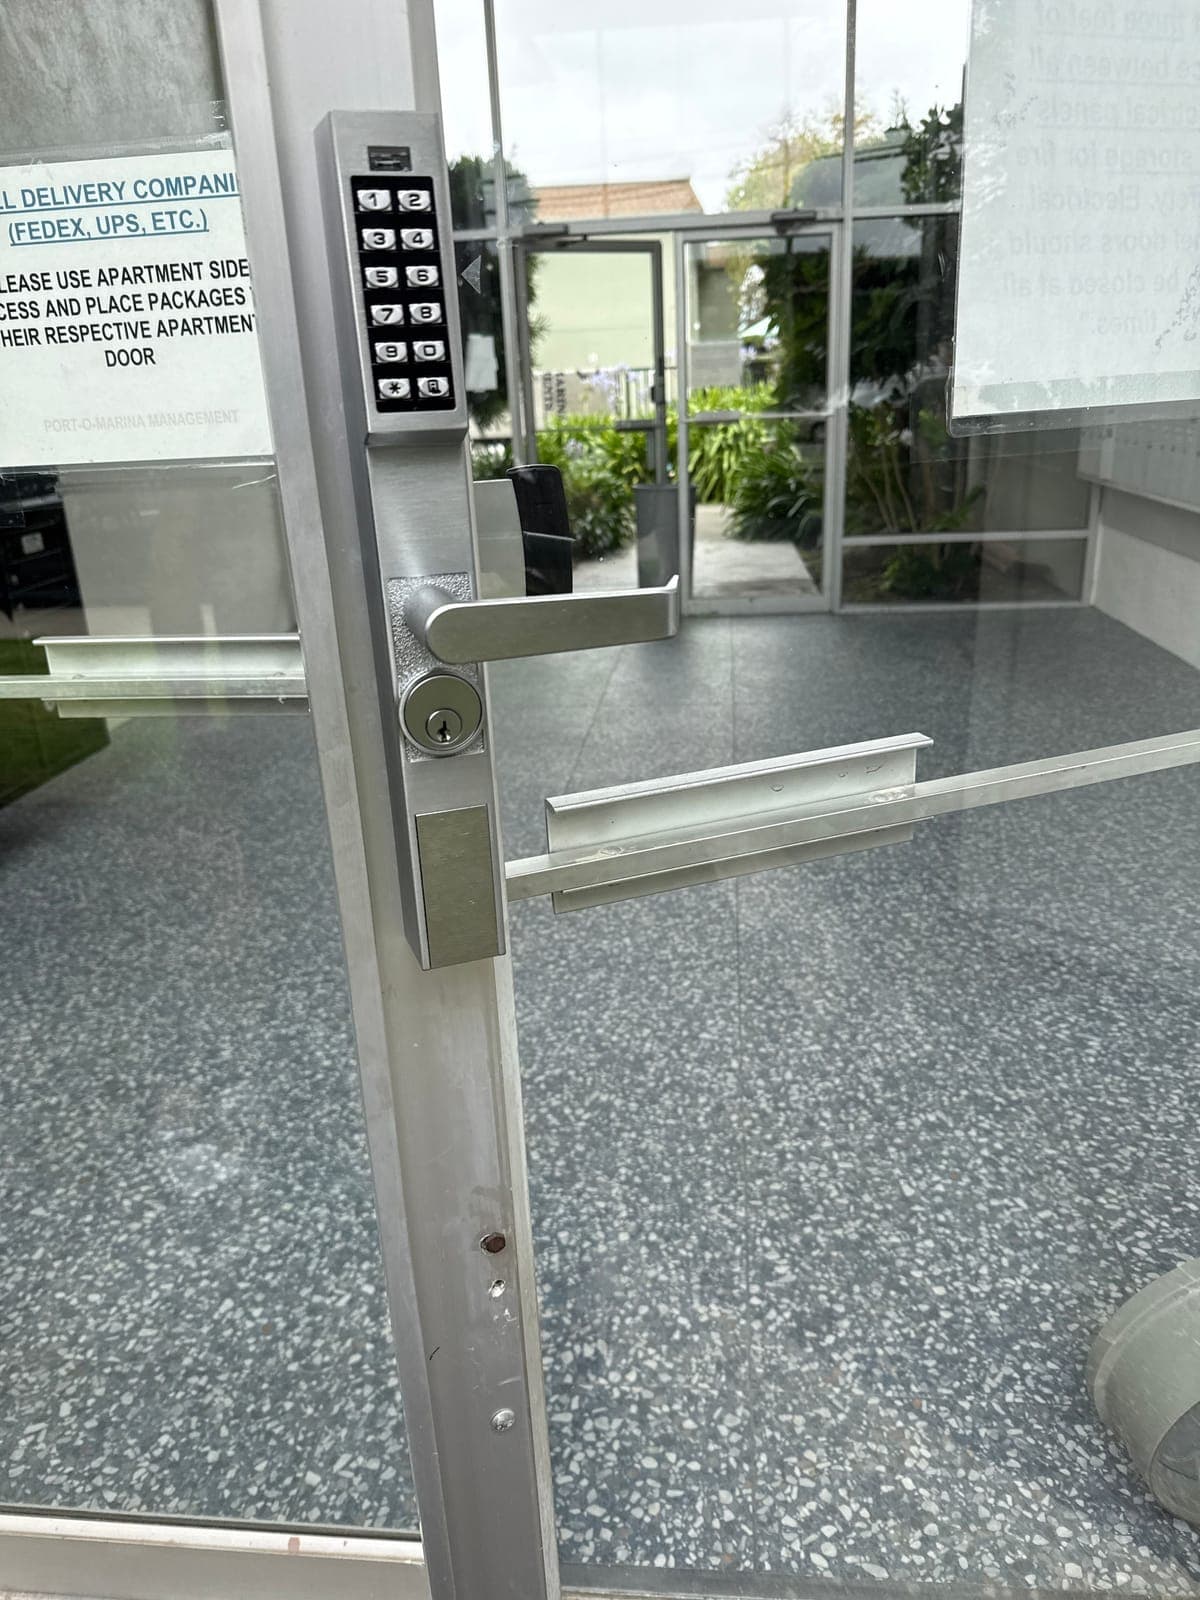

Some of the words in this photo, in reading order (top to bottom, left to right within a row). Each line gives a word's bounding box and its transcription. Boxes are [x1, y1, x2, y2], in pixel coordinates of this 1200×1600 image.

[0, 191, 16, 210] L
[21, 180, 126, 208] DELIVERY
[133, 172, 240, 199] COMPANI
[367, 193, 378, 207] 1
[409, 194, 421, 207] 2
[9, 217, 91, 244] (FEDEX,
[96, 213, 146, 236] UPS,
[151, 208, 208, 231] ETC.)
[373, 232, 386, 245] 3
[411, 232, 424, 245] 4
[56, 269, 93, 290] USE
[97, 261, 203, 287] APARTMENT
[376, 271, 389, 284] 5
[416, 269, 429, 282] 6
[46, 297, 81, 317] AND
[85, 293, 144, 315] PLACE
[147, 286, 246, 311] PACKAGES
[381, 307, 394, 321] 7
[420, 306, 433, 319] 8
[0, 327, 41, 347] HEIR
[44, 320, 152, 345] RESPECTIVE
[157, 313, 255, 338] APARTMEN
[104, 347, 156, 367] DOOR
[386, 345, 398, 358] 9
[43, 413, 146, 433] PORT-O-MARINA
[148, 408, 240, 428] MANAGEMENT
